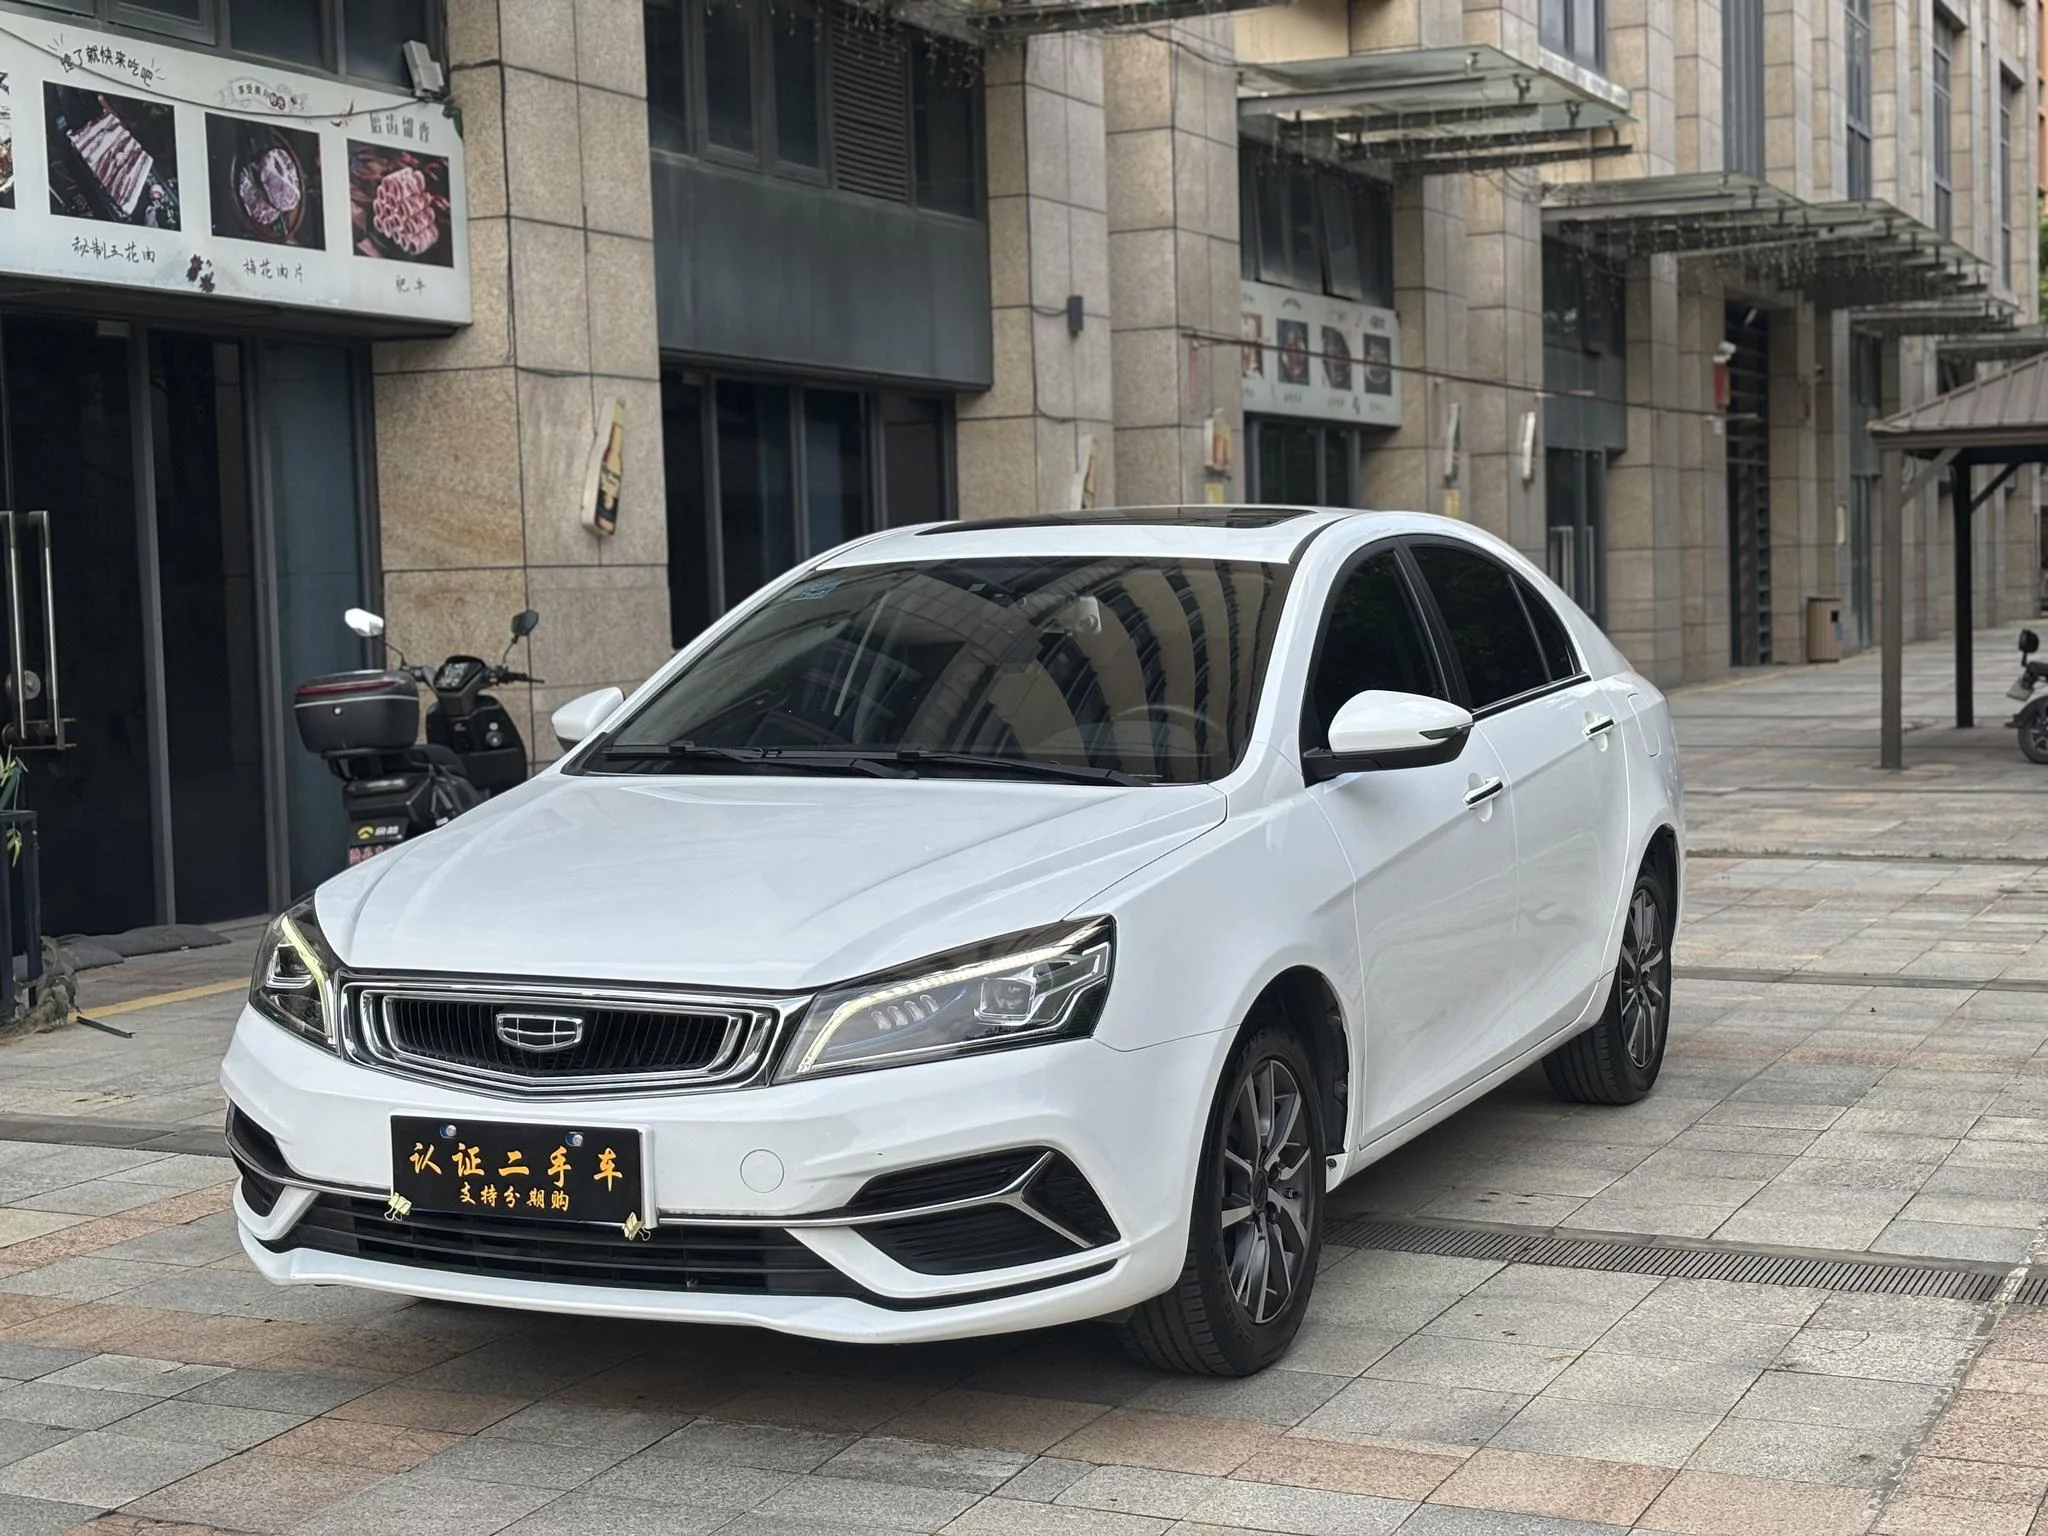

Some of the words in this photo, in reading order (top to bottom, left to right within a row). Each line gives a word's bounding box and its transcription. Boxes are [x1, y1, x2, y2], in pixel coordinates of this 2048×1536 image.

[71, 235, 156, 264] 秘制五花肉
[242, 256, 304, 283] 梅花肉片
[408, 1141, 624, 1192] 认证二手车
[458, 1181, 571, 1212] 支持分期购
